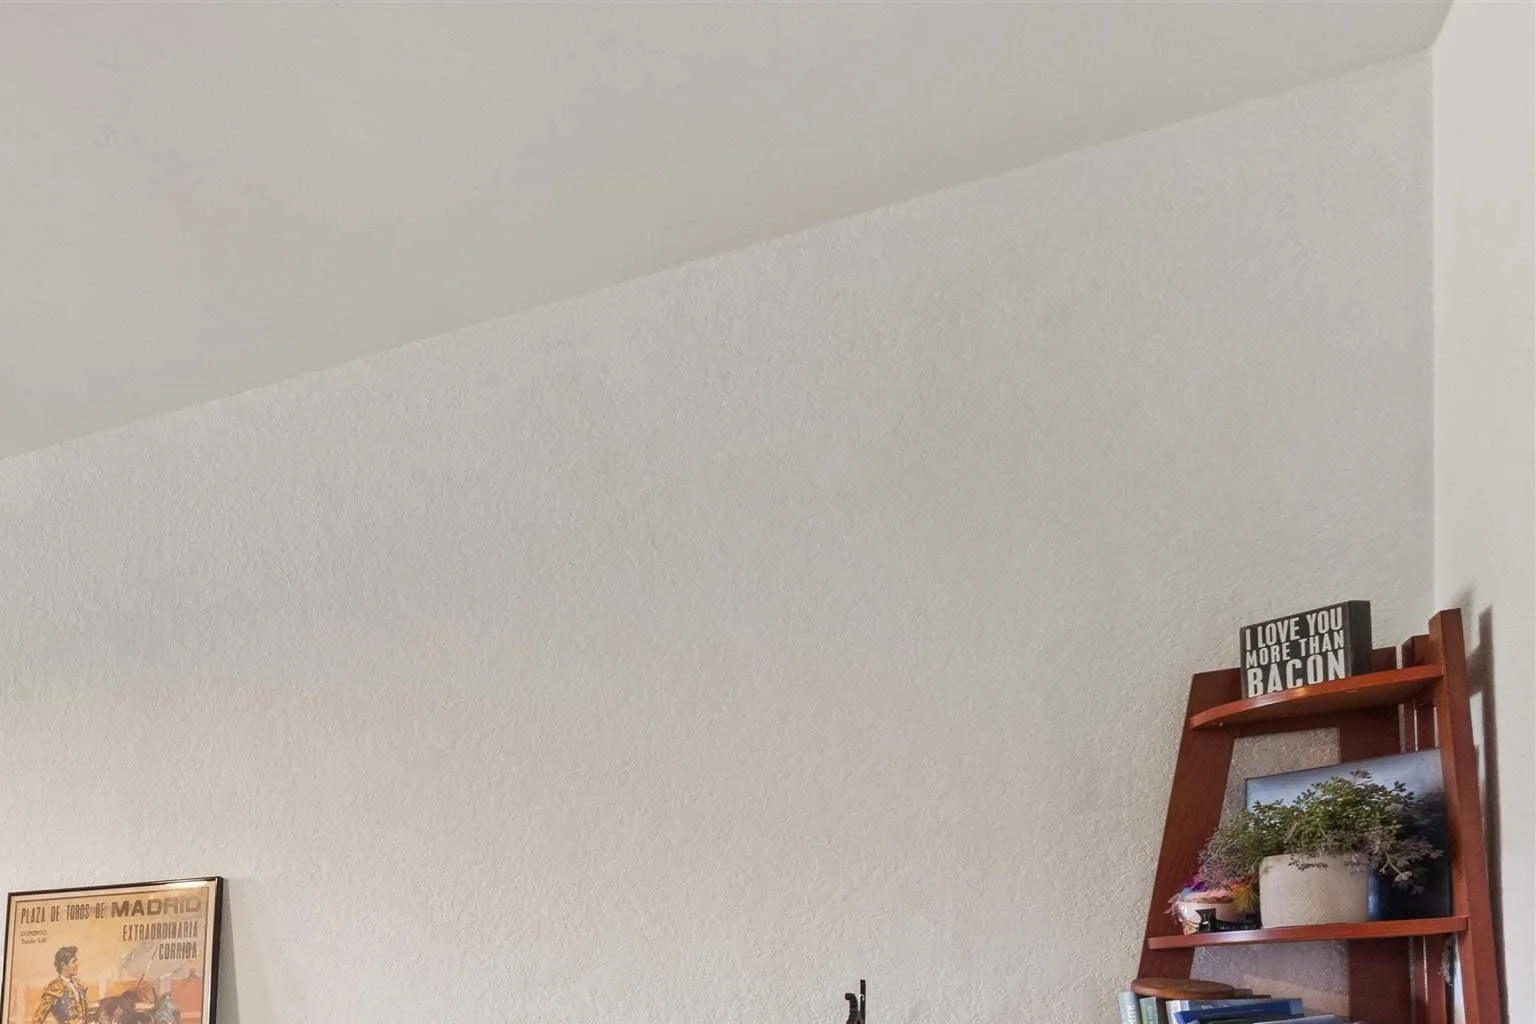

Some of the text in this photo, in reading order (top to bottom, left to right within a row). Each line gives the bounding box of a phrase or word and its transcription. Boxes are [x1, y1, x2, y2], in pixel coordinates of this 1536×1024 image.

[1245, 607, 1343, 651] I LOVE YOU
[1246, 629, 1344, 669] MORE THAN
[1247, 650, 1346, 698] BACON
[20, 896, 202, 925] PLAZA DE TOROS DE MADRID
[122, 921, 198, 942] EXTRAORDINARIA
[158, 942, 198, 960] CORRIDA
